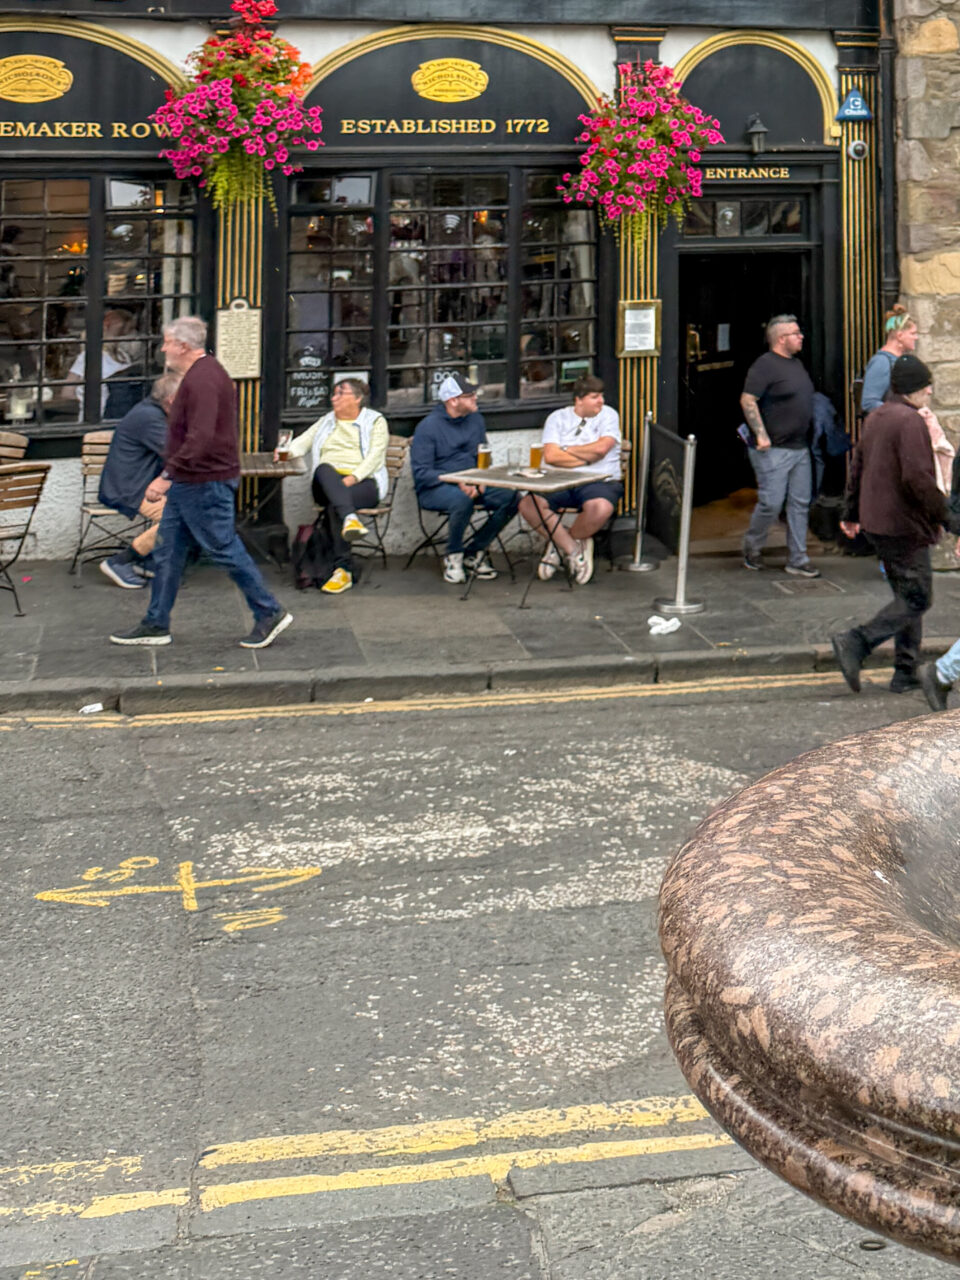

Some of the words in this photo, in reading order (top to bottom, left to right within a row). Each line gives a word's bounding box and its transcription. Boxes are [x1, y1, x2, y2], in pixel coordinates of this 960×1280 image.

[340, 119, 497, 134] ESTABLISHED
[505, 118, 550, 133] 1772
[705, 167, 790, 179] ENTRANCE
